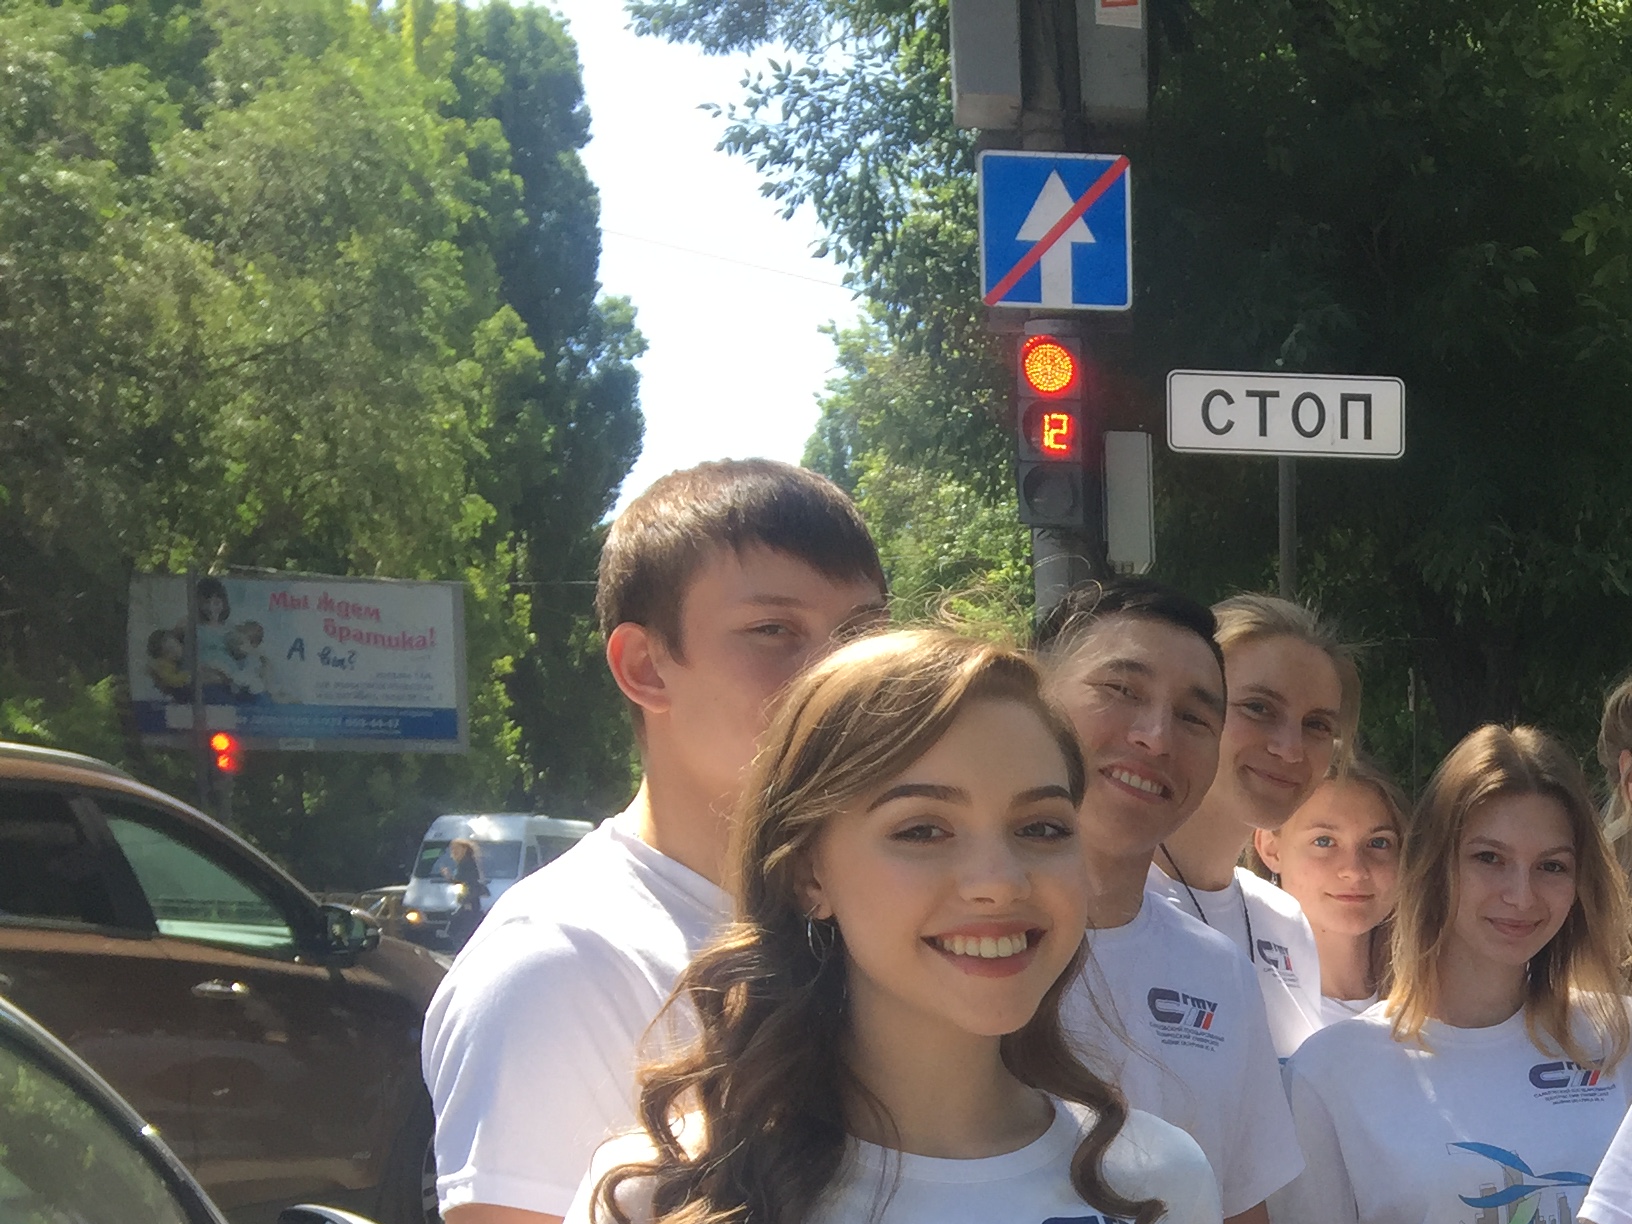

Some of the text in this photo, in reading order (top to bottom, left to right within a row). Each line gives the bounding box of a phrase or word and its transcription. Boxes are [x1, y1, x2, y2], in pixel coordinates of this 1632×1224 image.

[1201, 388, 1373, 441] СТОП
[1043, 413, 1068, 449] 12
[268, 591, 309, 611] Мы
[287, 638, 305, 661] А
